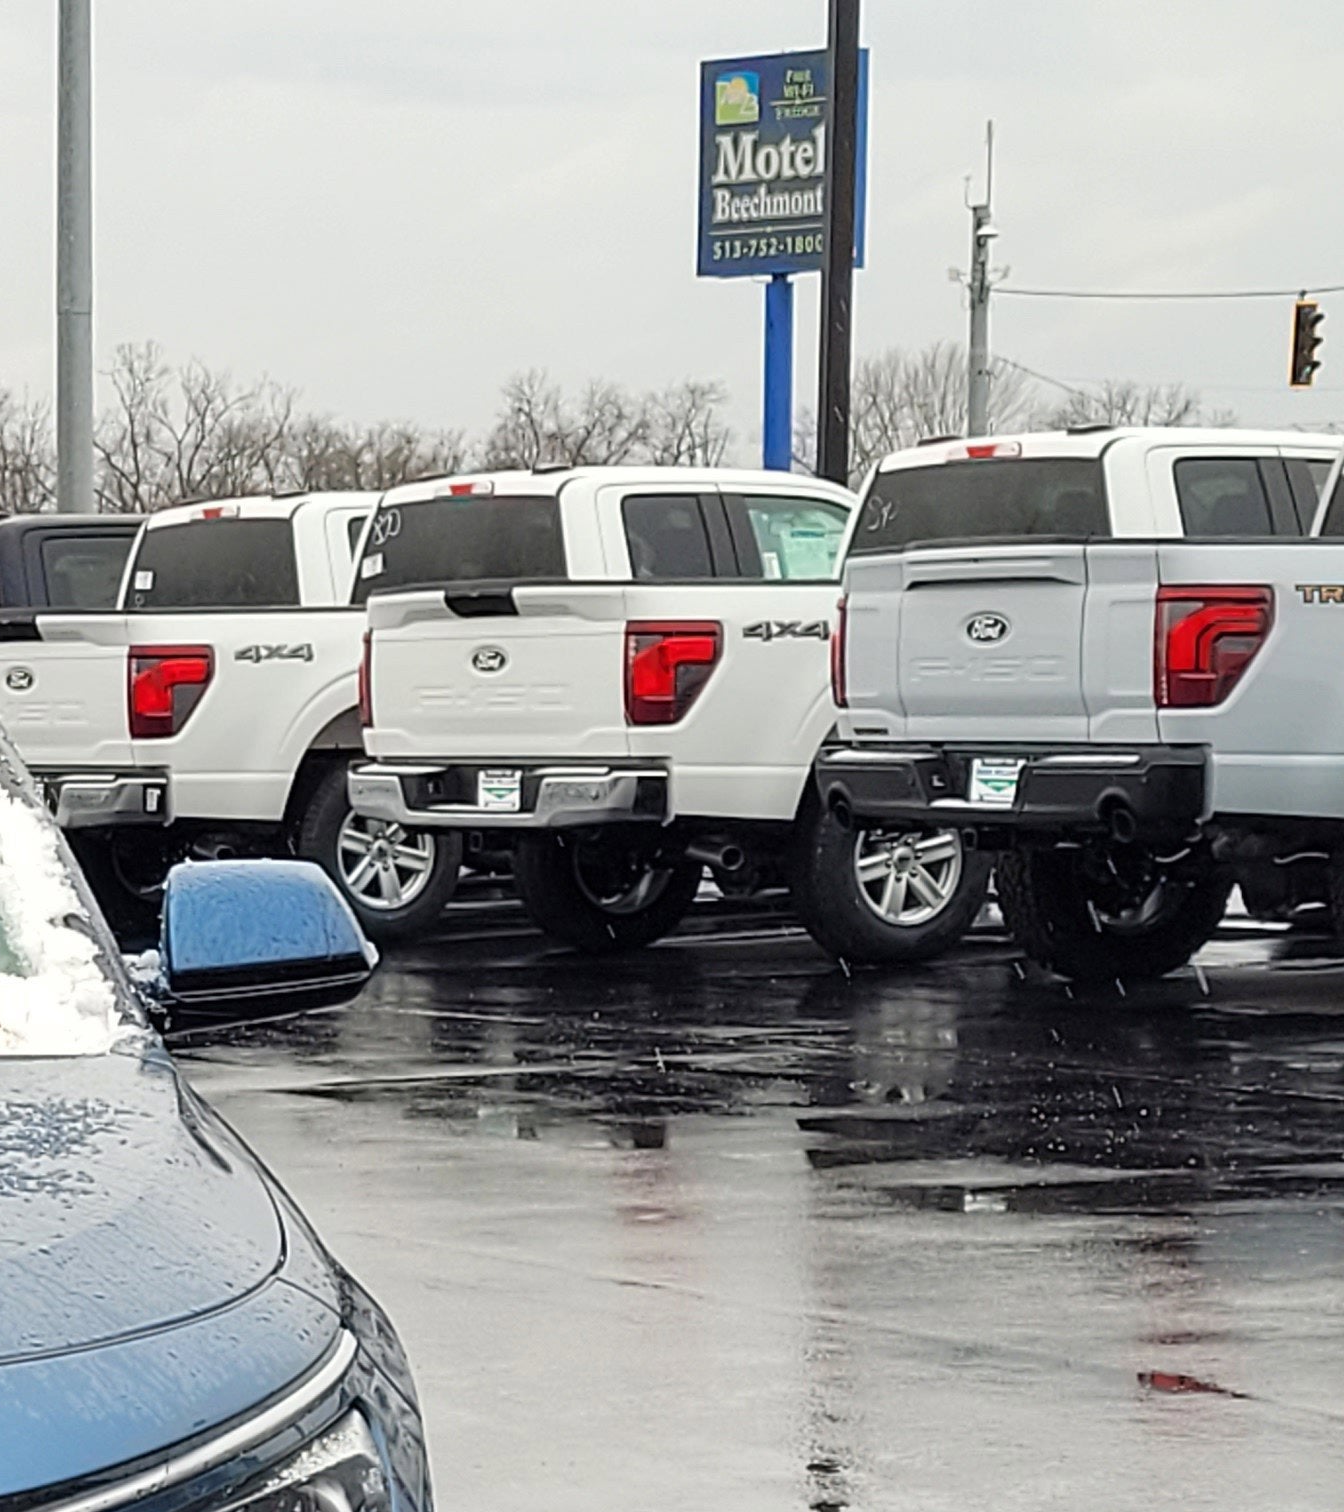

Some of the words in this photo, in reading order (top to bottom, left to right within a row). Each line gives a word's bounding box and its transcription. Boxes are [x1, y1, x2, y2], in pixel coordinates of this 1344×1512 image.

[712, 123, 826, 184] Motel
[713, 183, 824, 224] Beechmont
[742, 621, 830, 642] 4X4
[234, 643, 314, 664] 4X4
